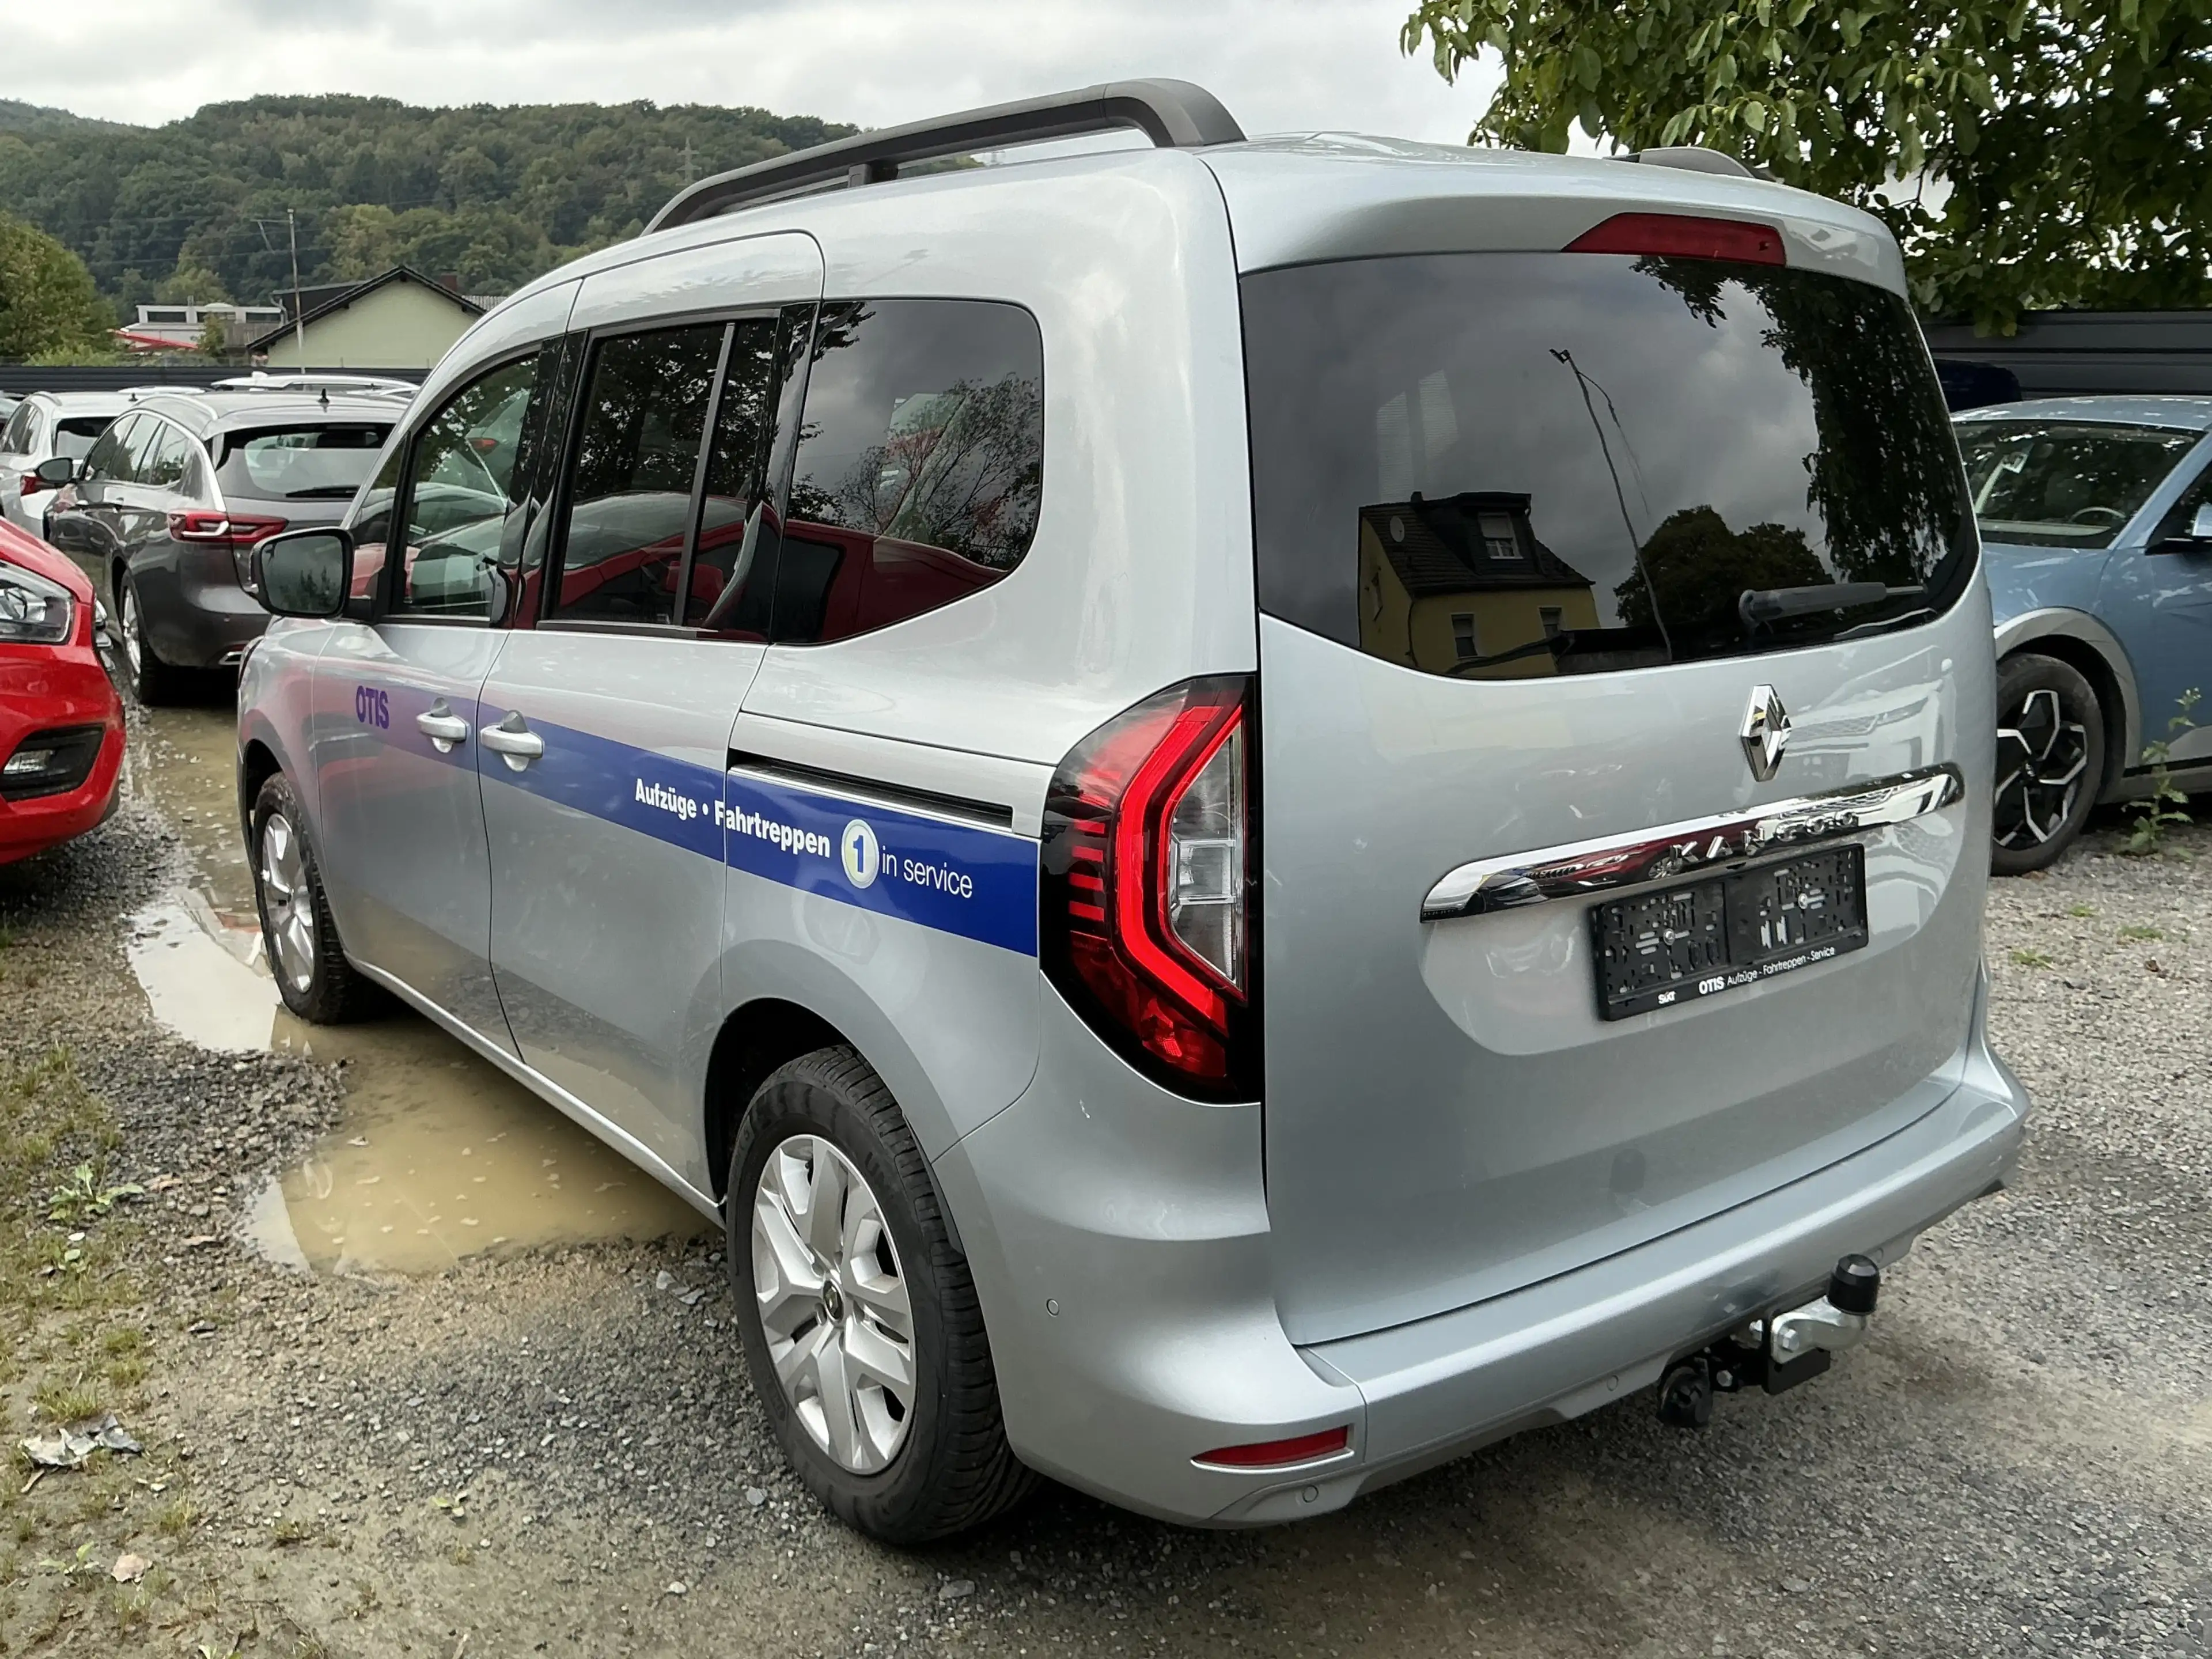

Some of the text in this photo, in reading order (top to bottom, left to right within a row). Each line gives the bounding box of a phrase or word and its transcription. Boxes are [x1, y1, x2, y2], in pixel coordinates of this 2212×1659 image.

[356, 685, 389, 729] OTIS
[635, 778, 696, 820] Aufzüge
[715, 800, 830, 858] Fahrtreppen
[853, 835, 972, 899] 1 in service
[1699, 976, 1725, 994] OTIS
[1728, 970, 1758, 986] Aufzüge
[1763, 955, 1806, 975] Fahrtreppen
[1810, 946, 1835, 961] Service
